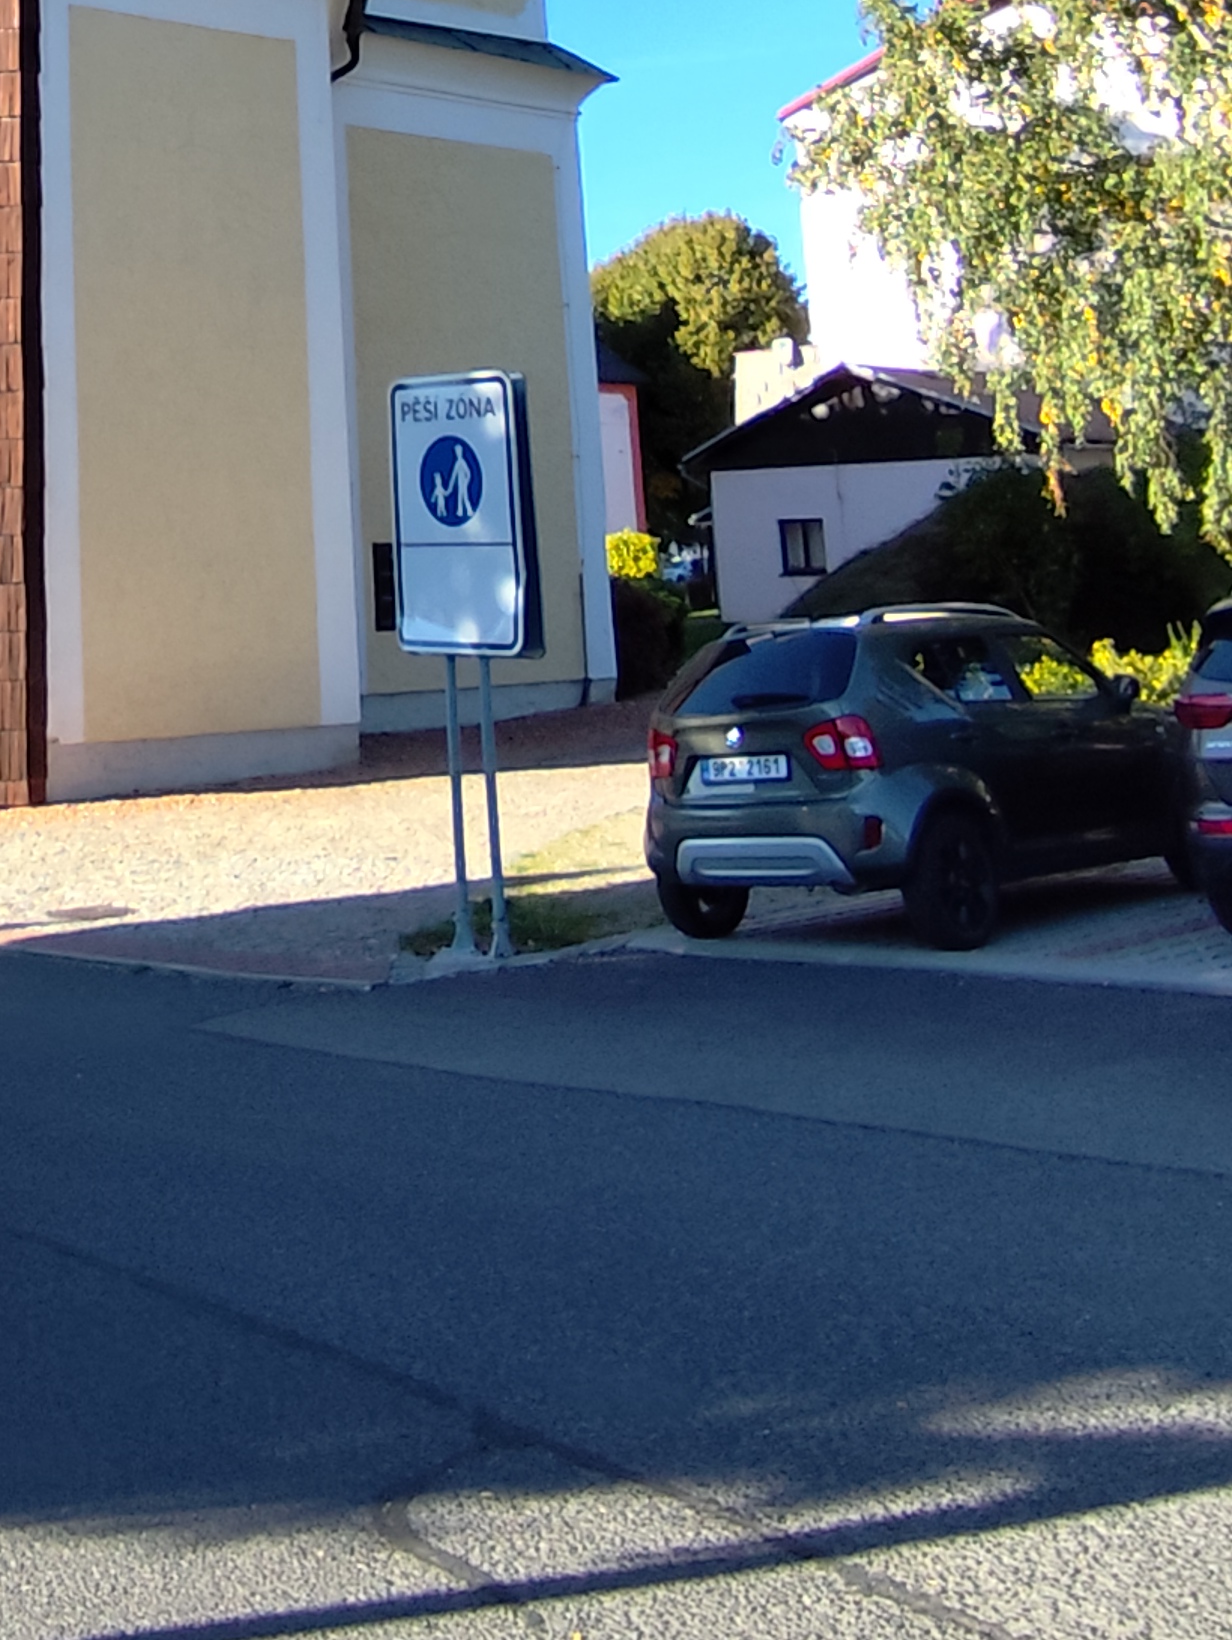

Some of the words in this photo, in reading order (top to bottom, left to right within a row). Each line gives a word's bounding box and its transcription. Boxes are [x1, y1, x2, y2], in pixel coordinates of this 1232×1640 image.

[401, 394, 439, 422] PĚŠÍ
[445, 393, 496, 420] ZÓNA
[746, 757, 780, 776] 2161
